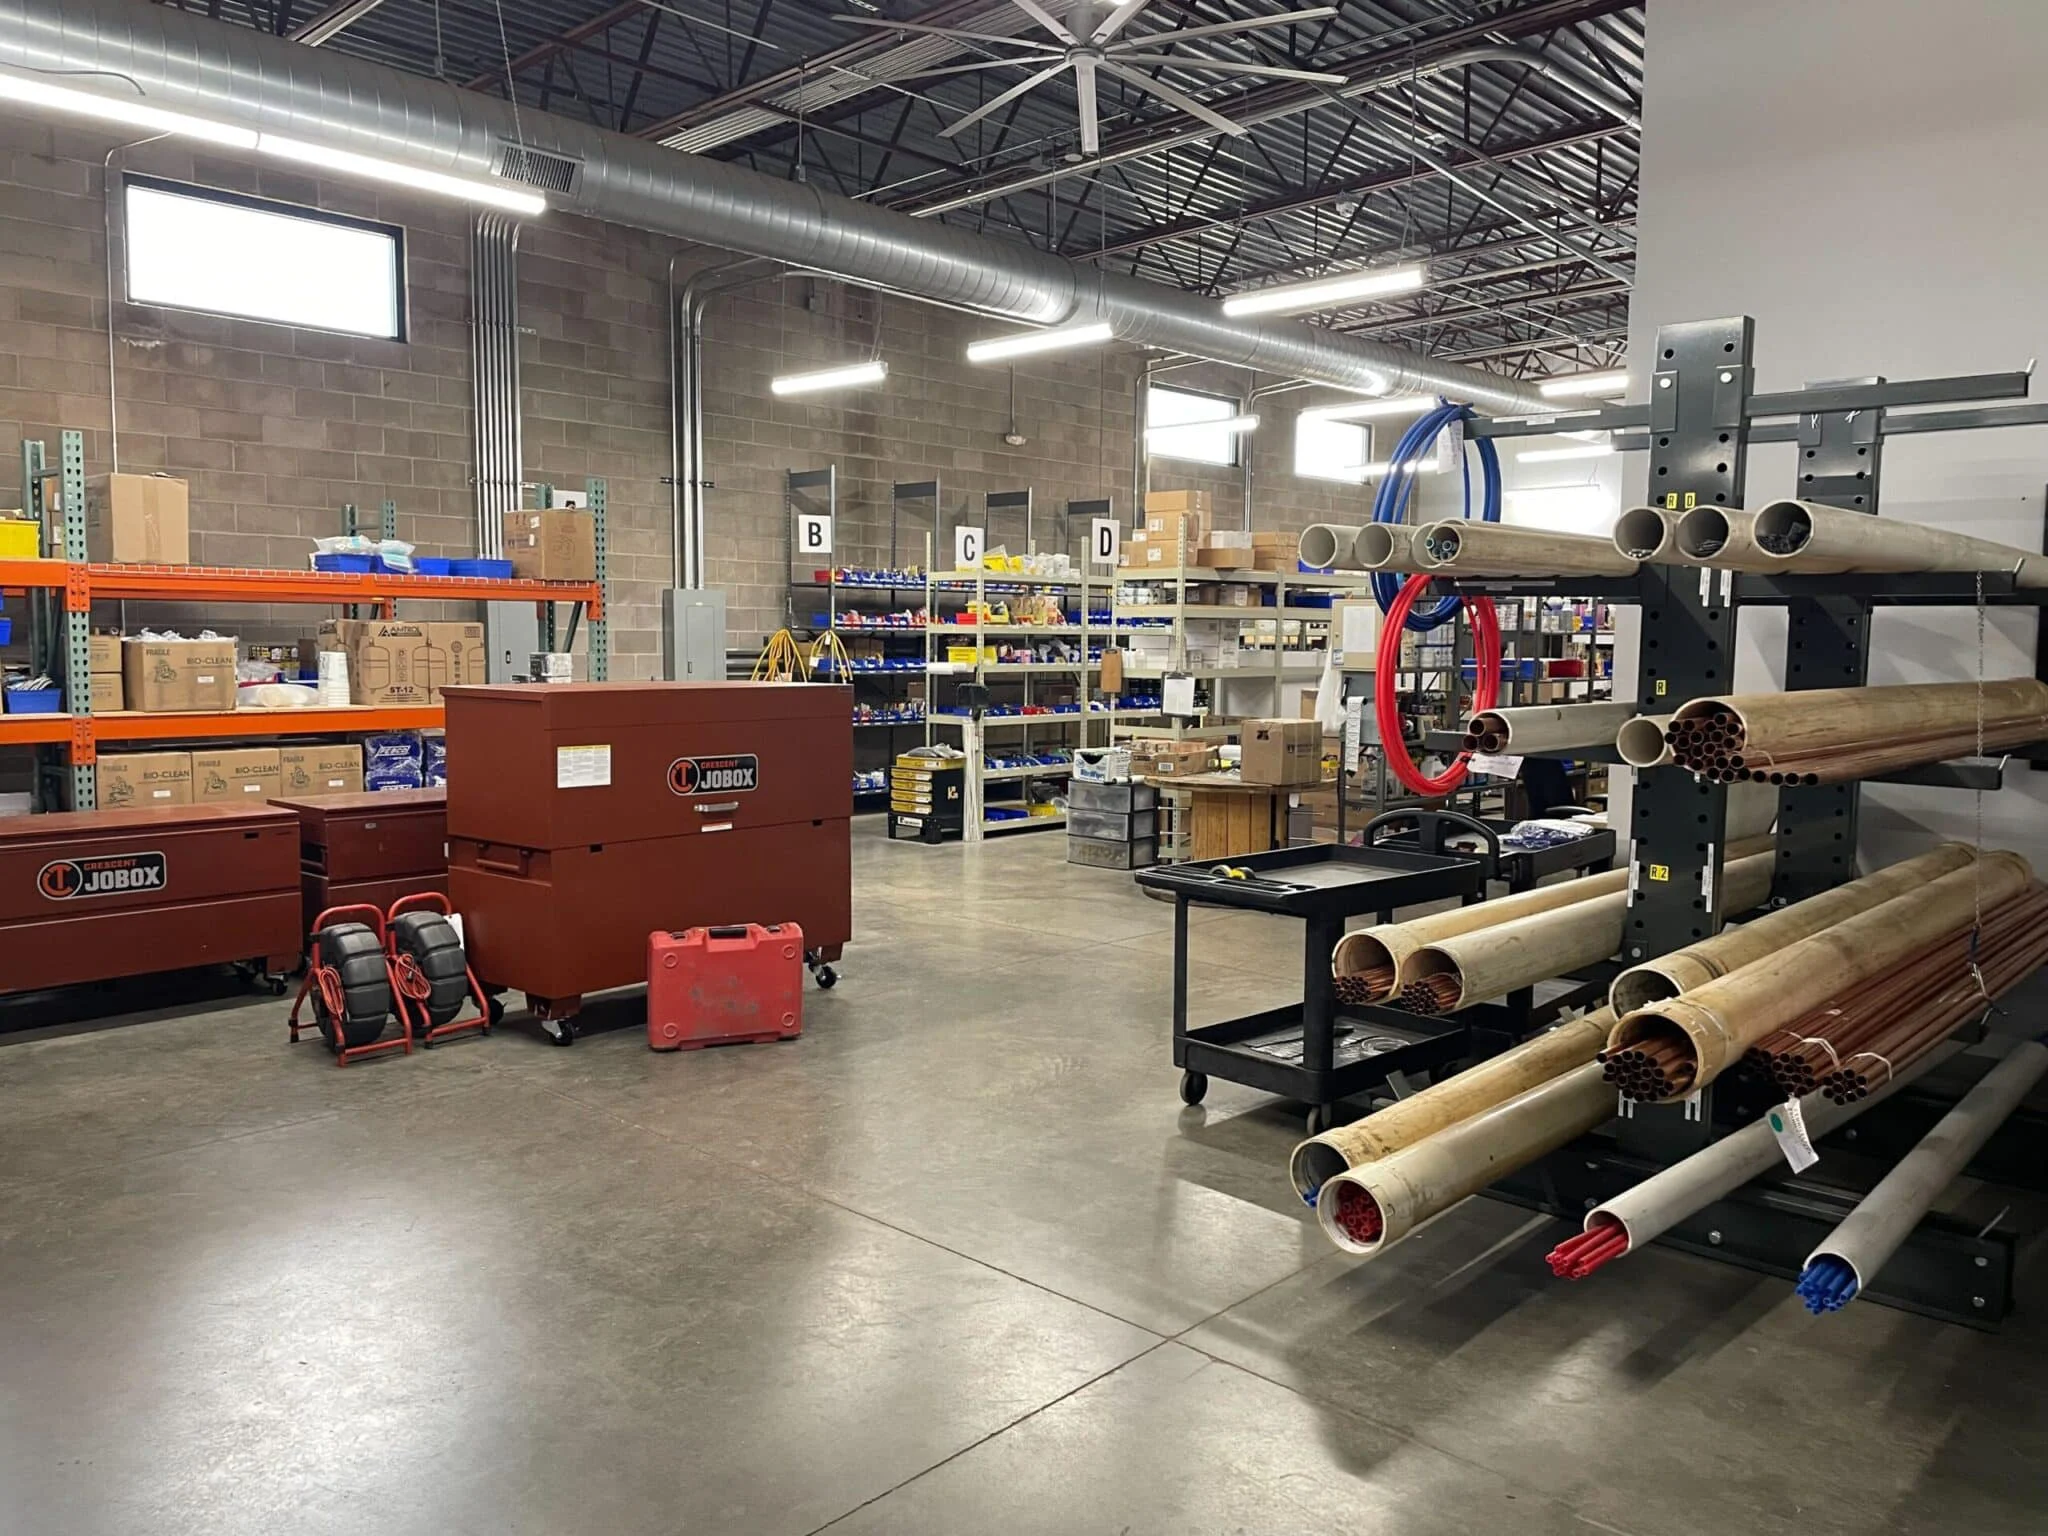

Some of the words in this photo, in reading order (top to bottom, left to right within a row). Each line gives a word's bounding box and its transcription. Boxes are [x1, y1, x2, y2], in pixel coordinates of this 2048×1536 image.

[808, 521, 822, 547] B
[1100, 526, 1112, 556] D
[963, 534, 975, 561] C
[186, 656, 232, 665] BIO-CLEAN
[235, 765, 279, 774] BIO-CLEAN
[318, 761, 360, 770] BIO-CLEAN
[700, 759, 738, 769] CRESCENT
[143, 769, 190, 780] BIO-CLEAN
[701, 768, 754, 789] JOBOX
[83, 858, 137, 870] CRESCENT
[84, 865, 161, 891] JOBOX
